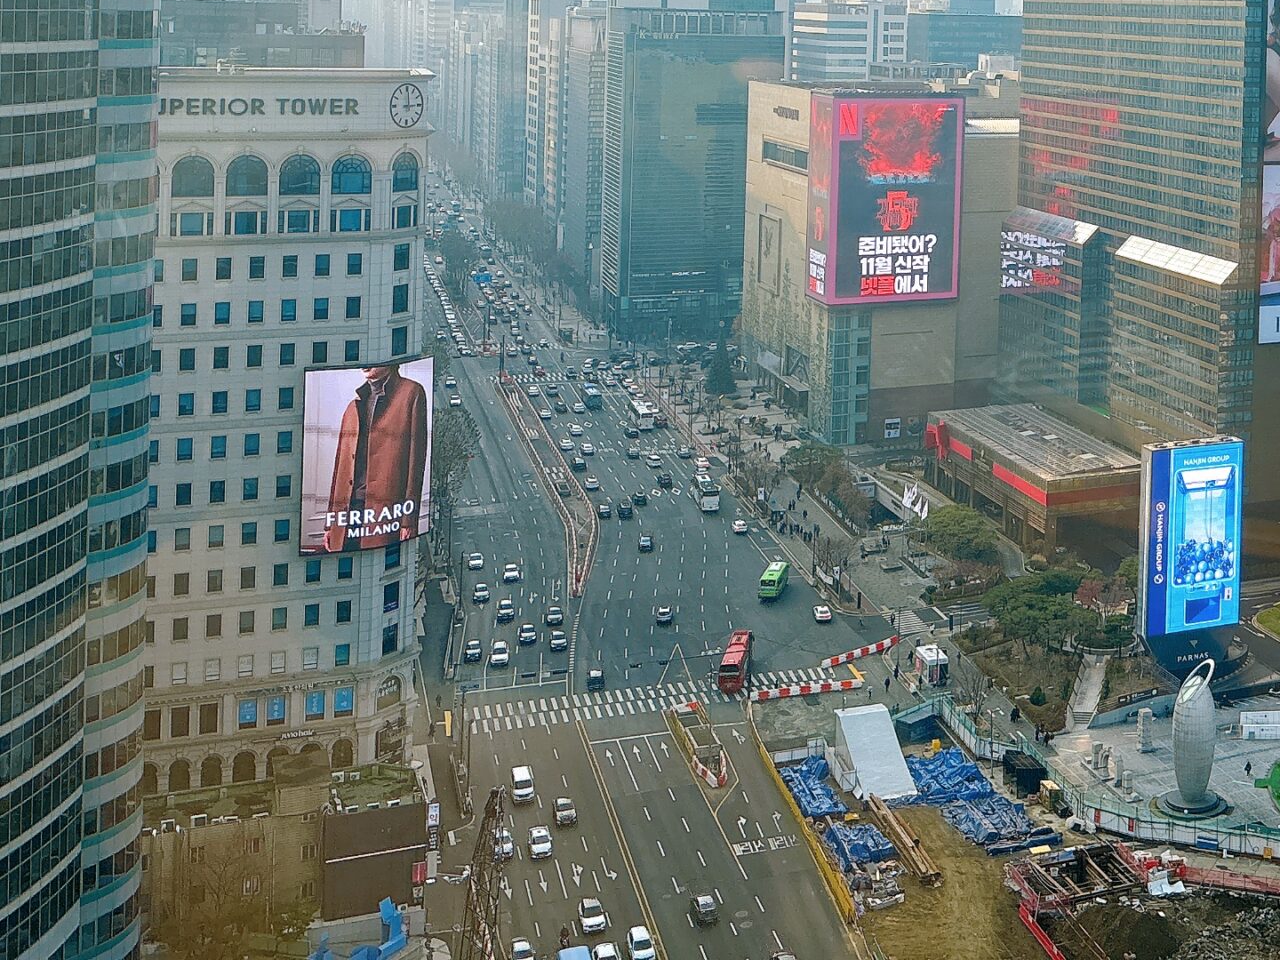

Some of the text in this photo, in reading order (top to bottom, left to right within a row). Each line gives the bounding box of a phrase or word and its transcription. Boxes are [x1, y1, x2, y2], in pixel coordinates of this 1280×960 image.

[276, 97, 359, 116] TOWER
[839, 103, 858, 135] N
[859, 234, 937, 256] 준비됐어?
[860, 254, 930, 276] 11월 신작
[860, 275, 928, 296] 넷플에서
[1207, 454, 1230, 464] GROUP
[325, 500, 414, 527] FERRARO
[347, 521, 400, 538] MILANO
[1155, 514, 1165, 572] HANJIN GROUP
[1177, 652, 1209, 663] PARNAS
